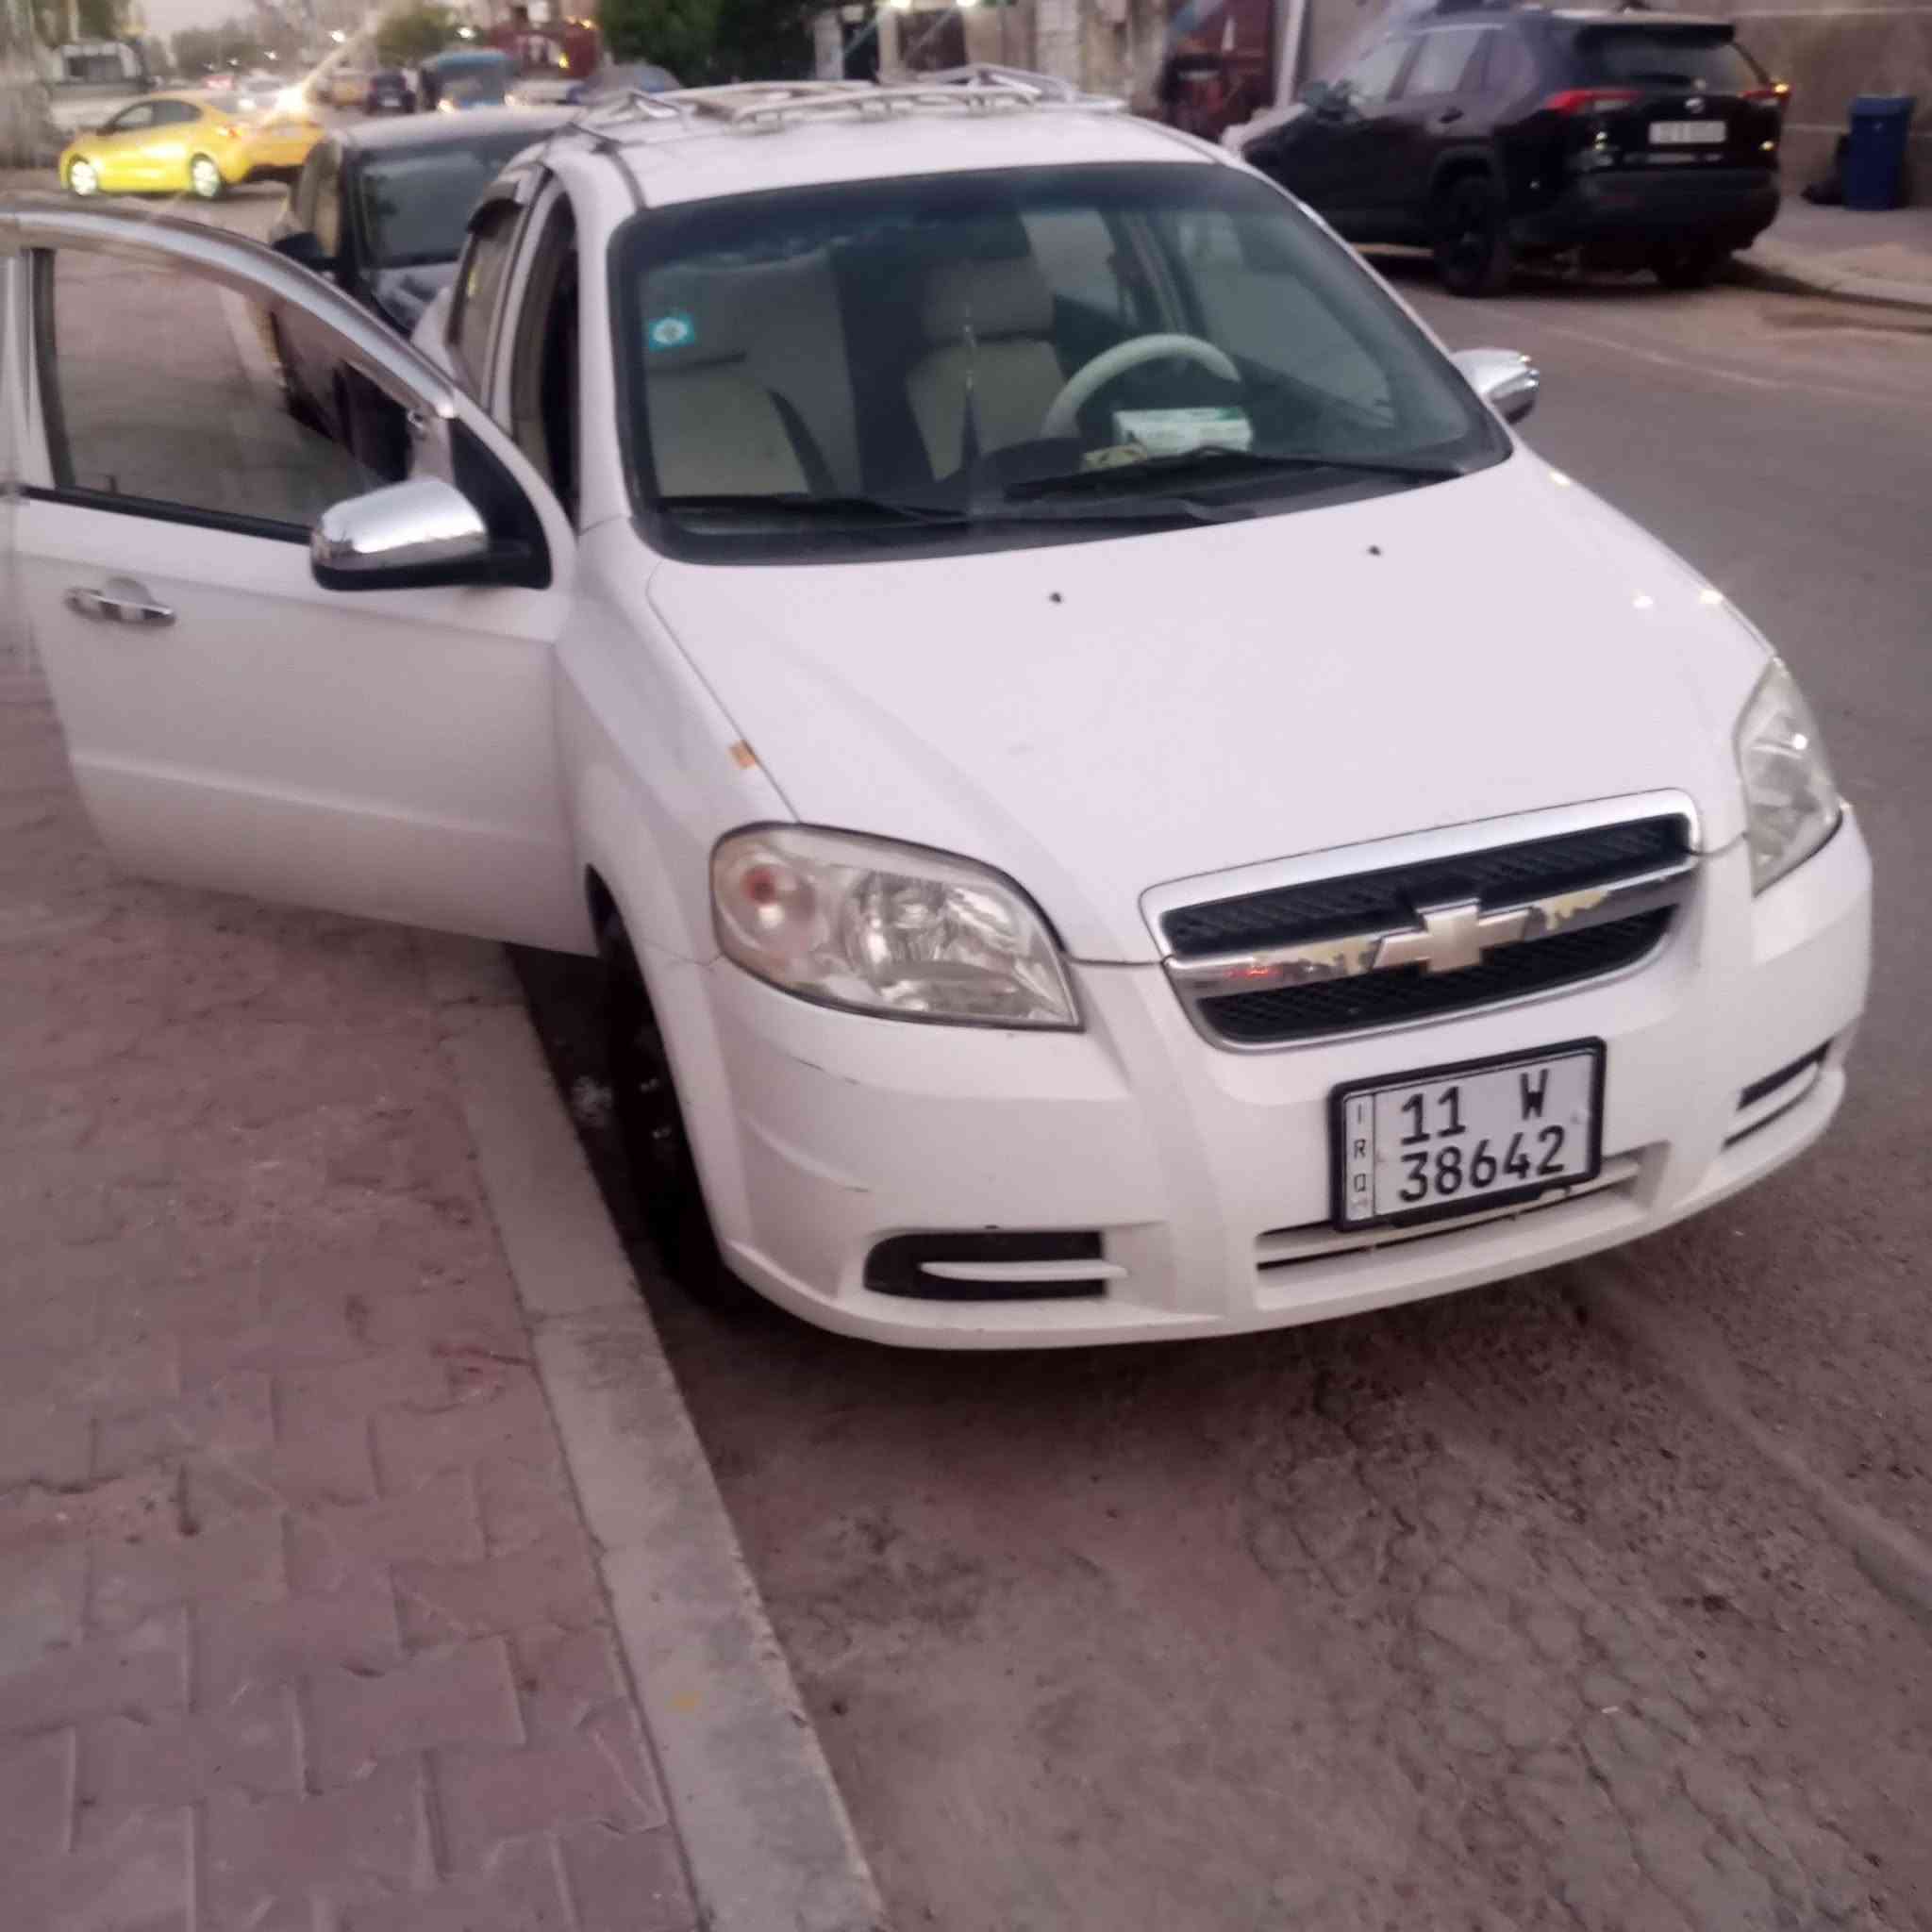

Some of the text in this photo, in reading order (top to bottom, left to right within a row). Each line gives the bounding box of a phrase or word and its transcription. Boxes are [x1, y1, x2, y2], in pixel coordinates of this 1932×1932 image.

[1400, 1069, 1548, 1145] 11 W
[1398, 1125, 1565, 1203] 38642
